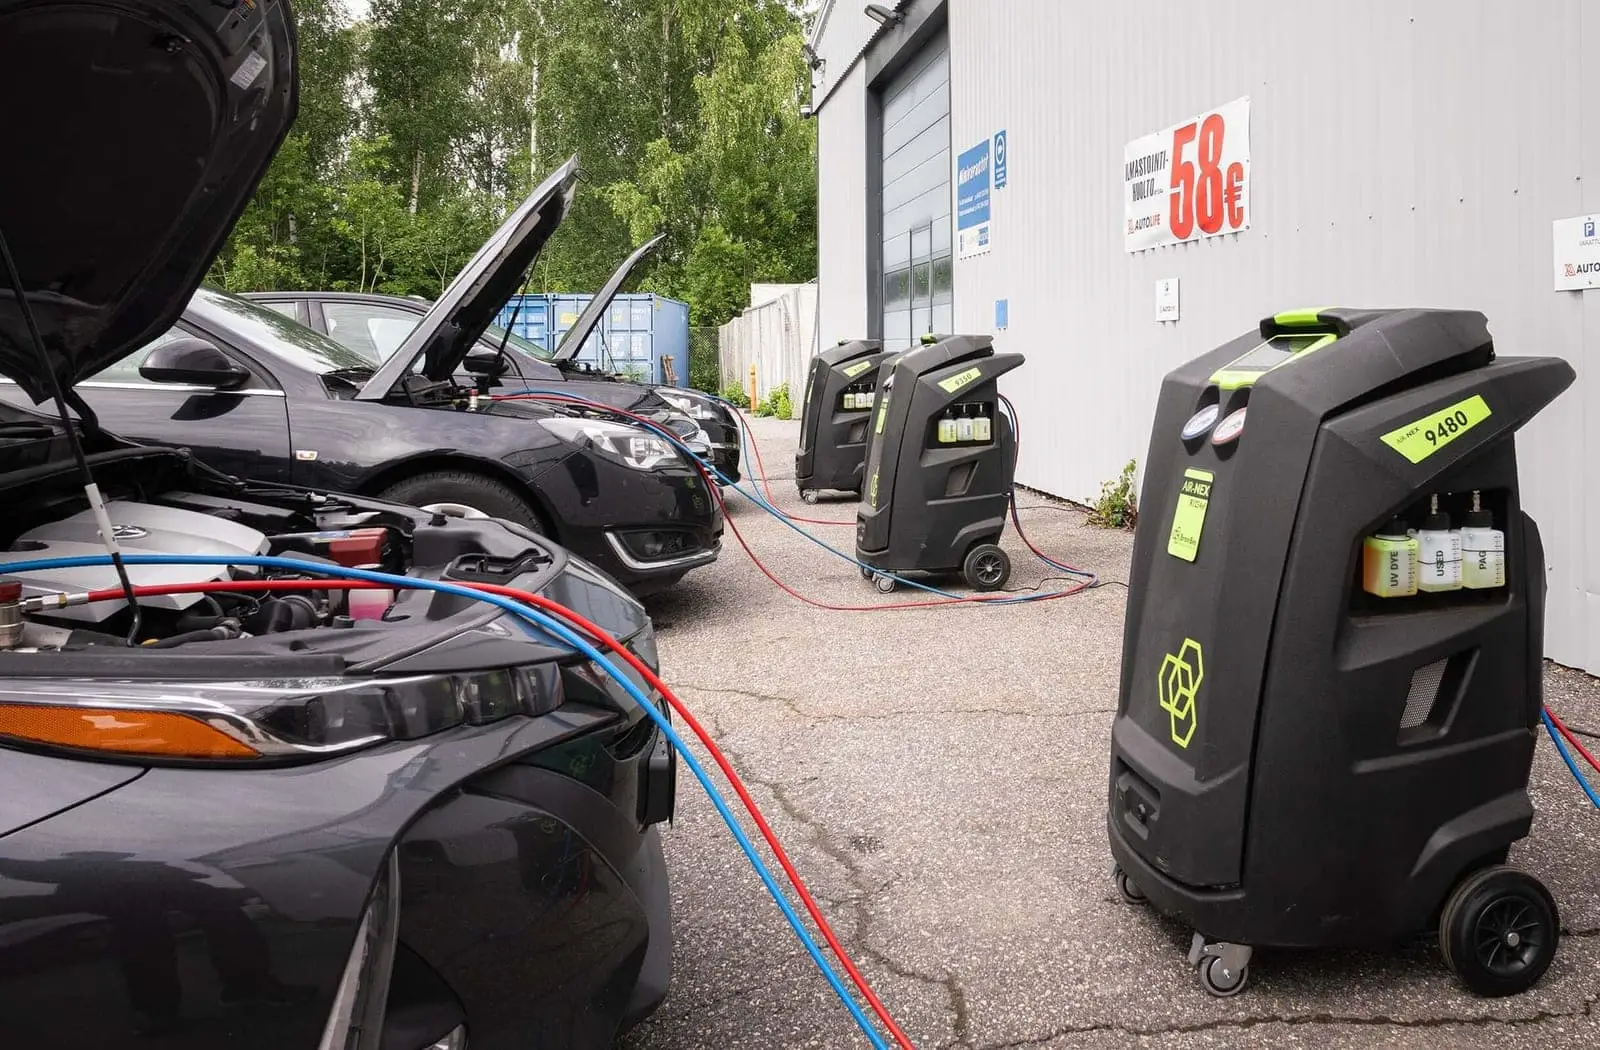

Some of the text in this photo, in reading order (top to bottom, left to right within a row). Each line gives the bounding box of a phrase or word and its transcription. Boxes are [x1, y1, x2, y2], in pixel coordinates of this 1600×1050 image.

[1126, 151, 1168, 181] ILMASTOINTI-
[1424, 410, 1468, 446] 9480
[1182, 481, 1210, 496] AIR-NEX
[1390, 551, 1399, 587] UV DYE
[1436, 550, 1445, 577] USED
[1479, 550, 1487, 570] PAG
